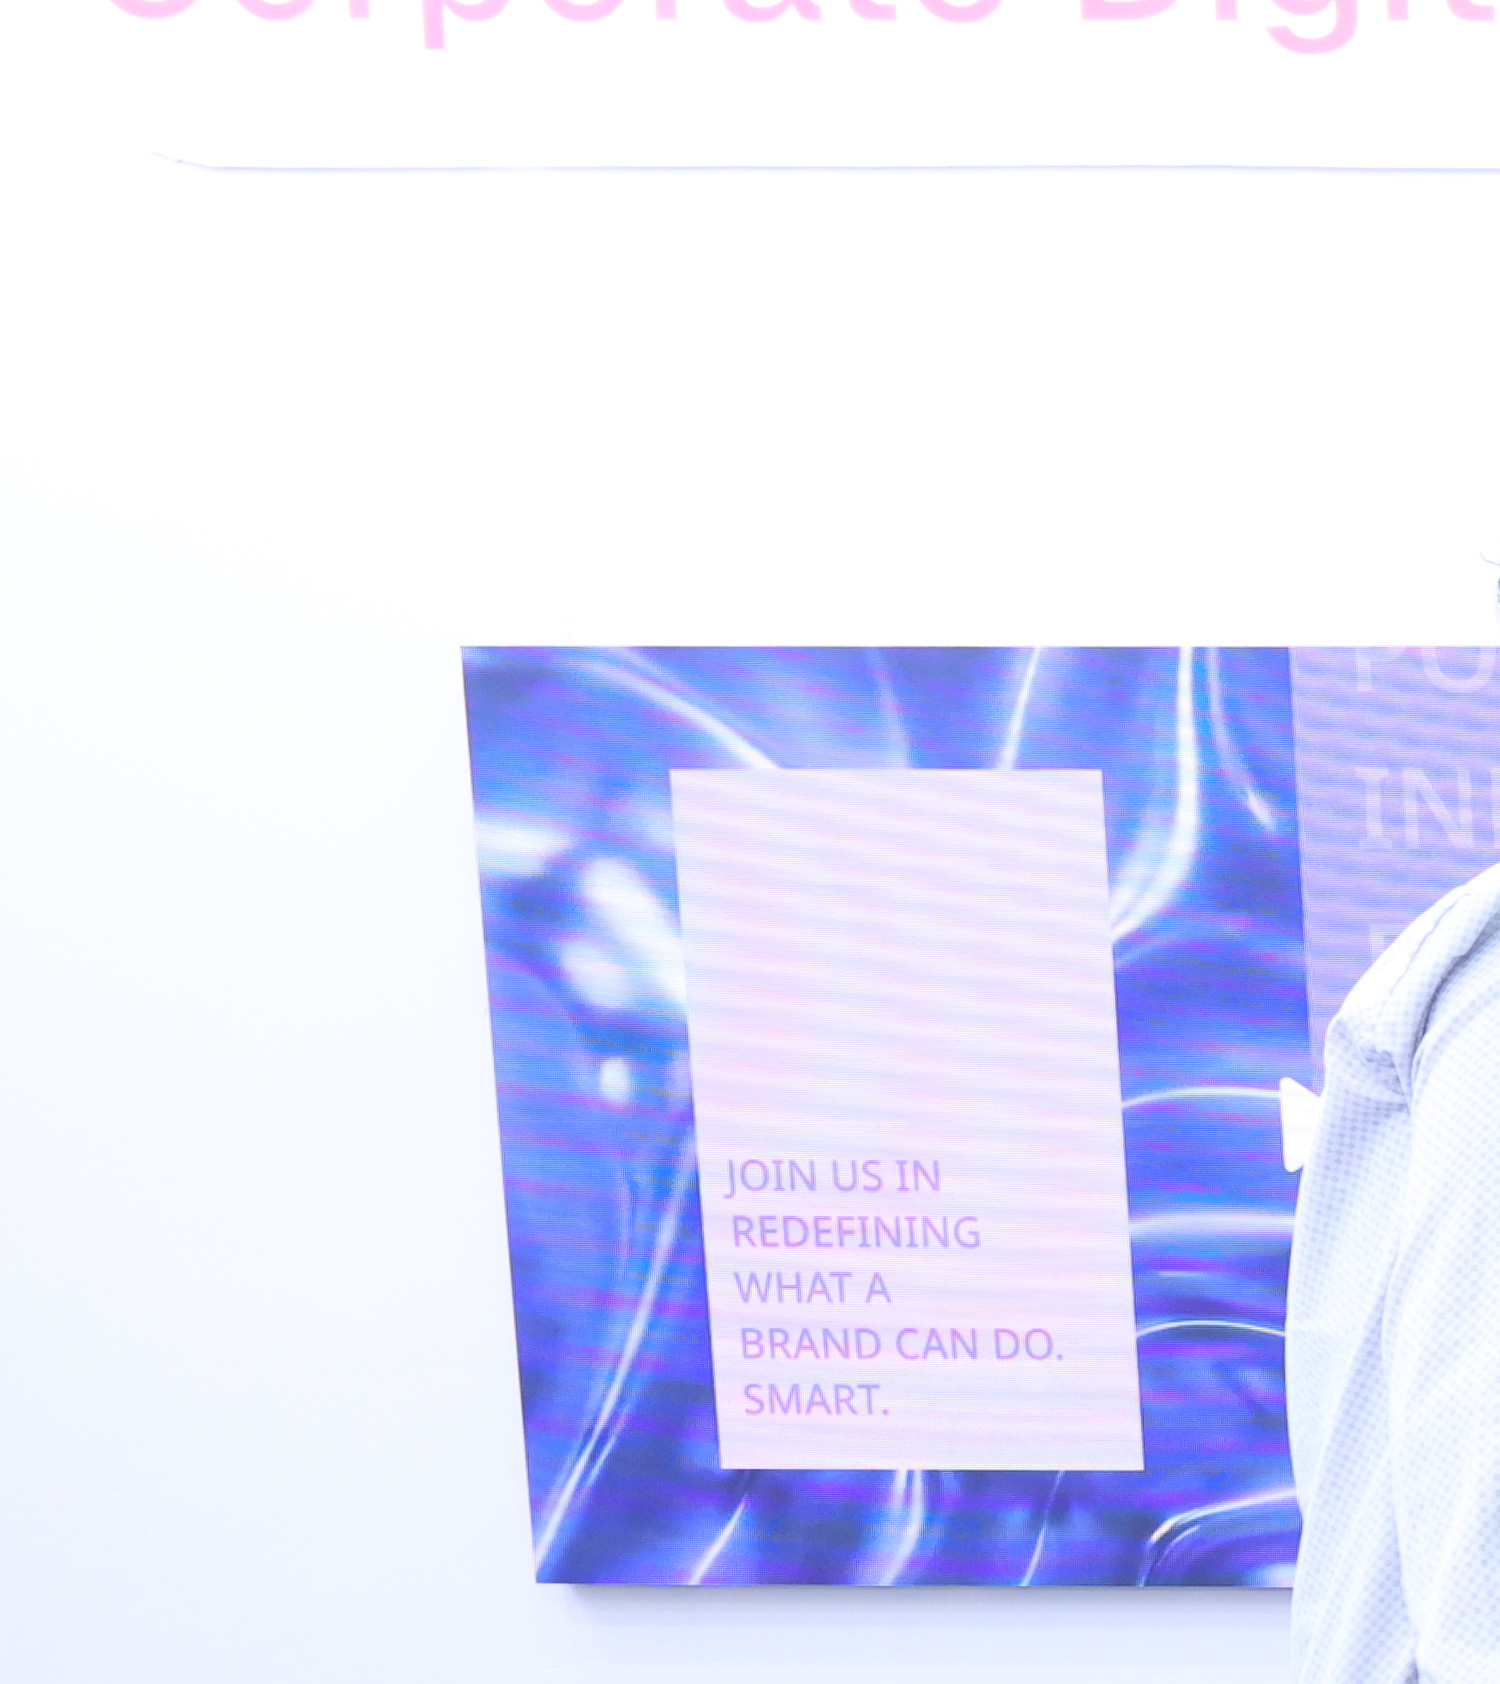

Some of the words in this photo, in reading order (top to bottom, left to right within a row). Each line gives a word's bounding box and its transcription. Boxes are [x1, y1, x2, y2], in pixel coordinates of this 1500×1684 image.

[725, 1158, 818, 1199] JOIN
[830, 1159, 884, 1193] US
[895, 1159, 942, 1192] IN
[732, 1214, 982, 1250] REDEFINING
[733, 1270, 853, 1305] WHAT
[865, 1270, 892, 1304] A
[740, 1327, 882, 1362] BRAND
[895, 1327, 980, 1362] CAN
[994, 1327, 1066, 1363] DO.
[744, 1382, 891, 1418] SMART.
